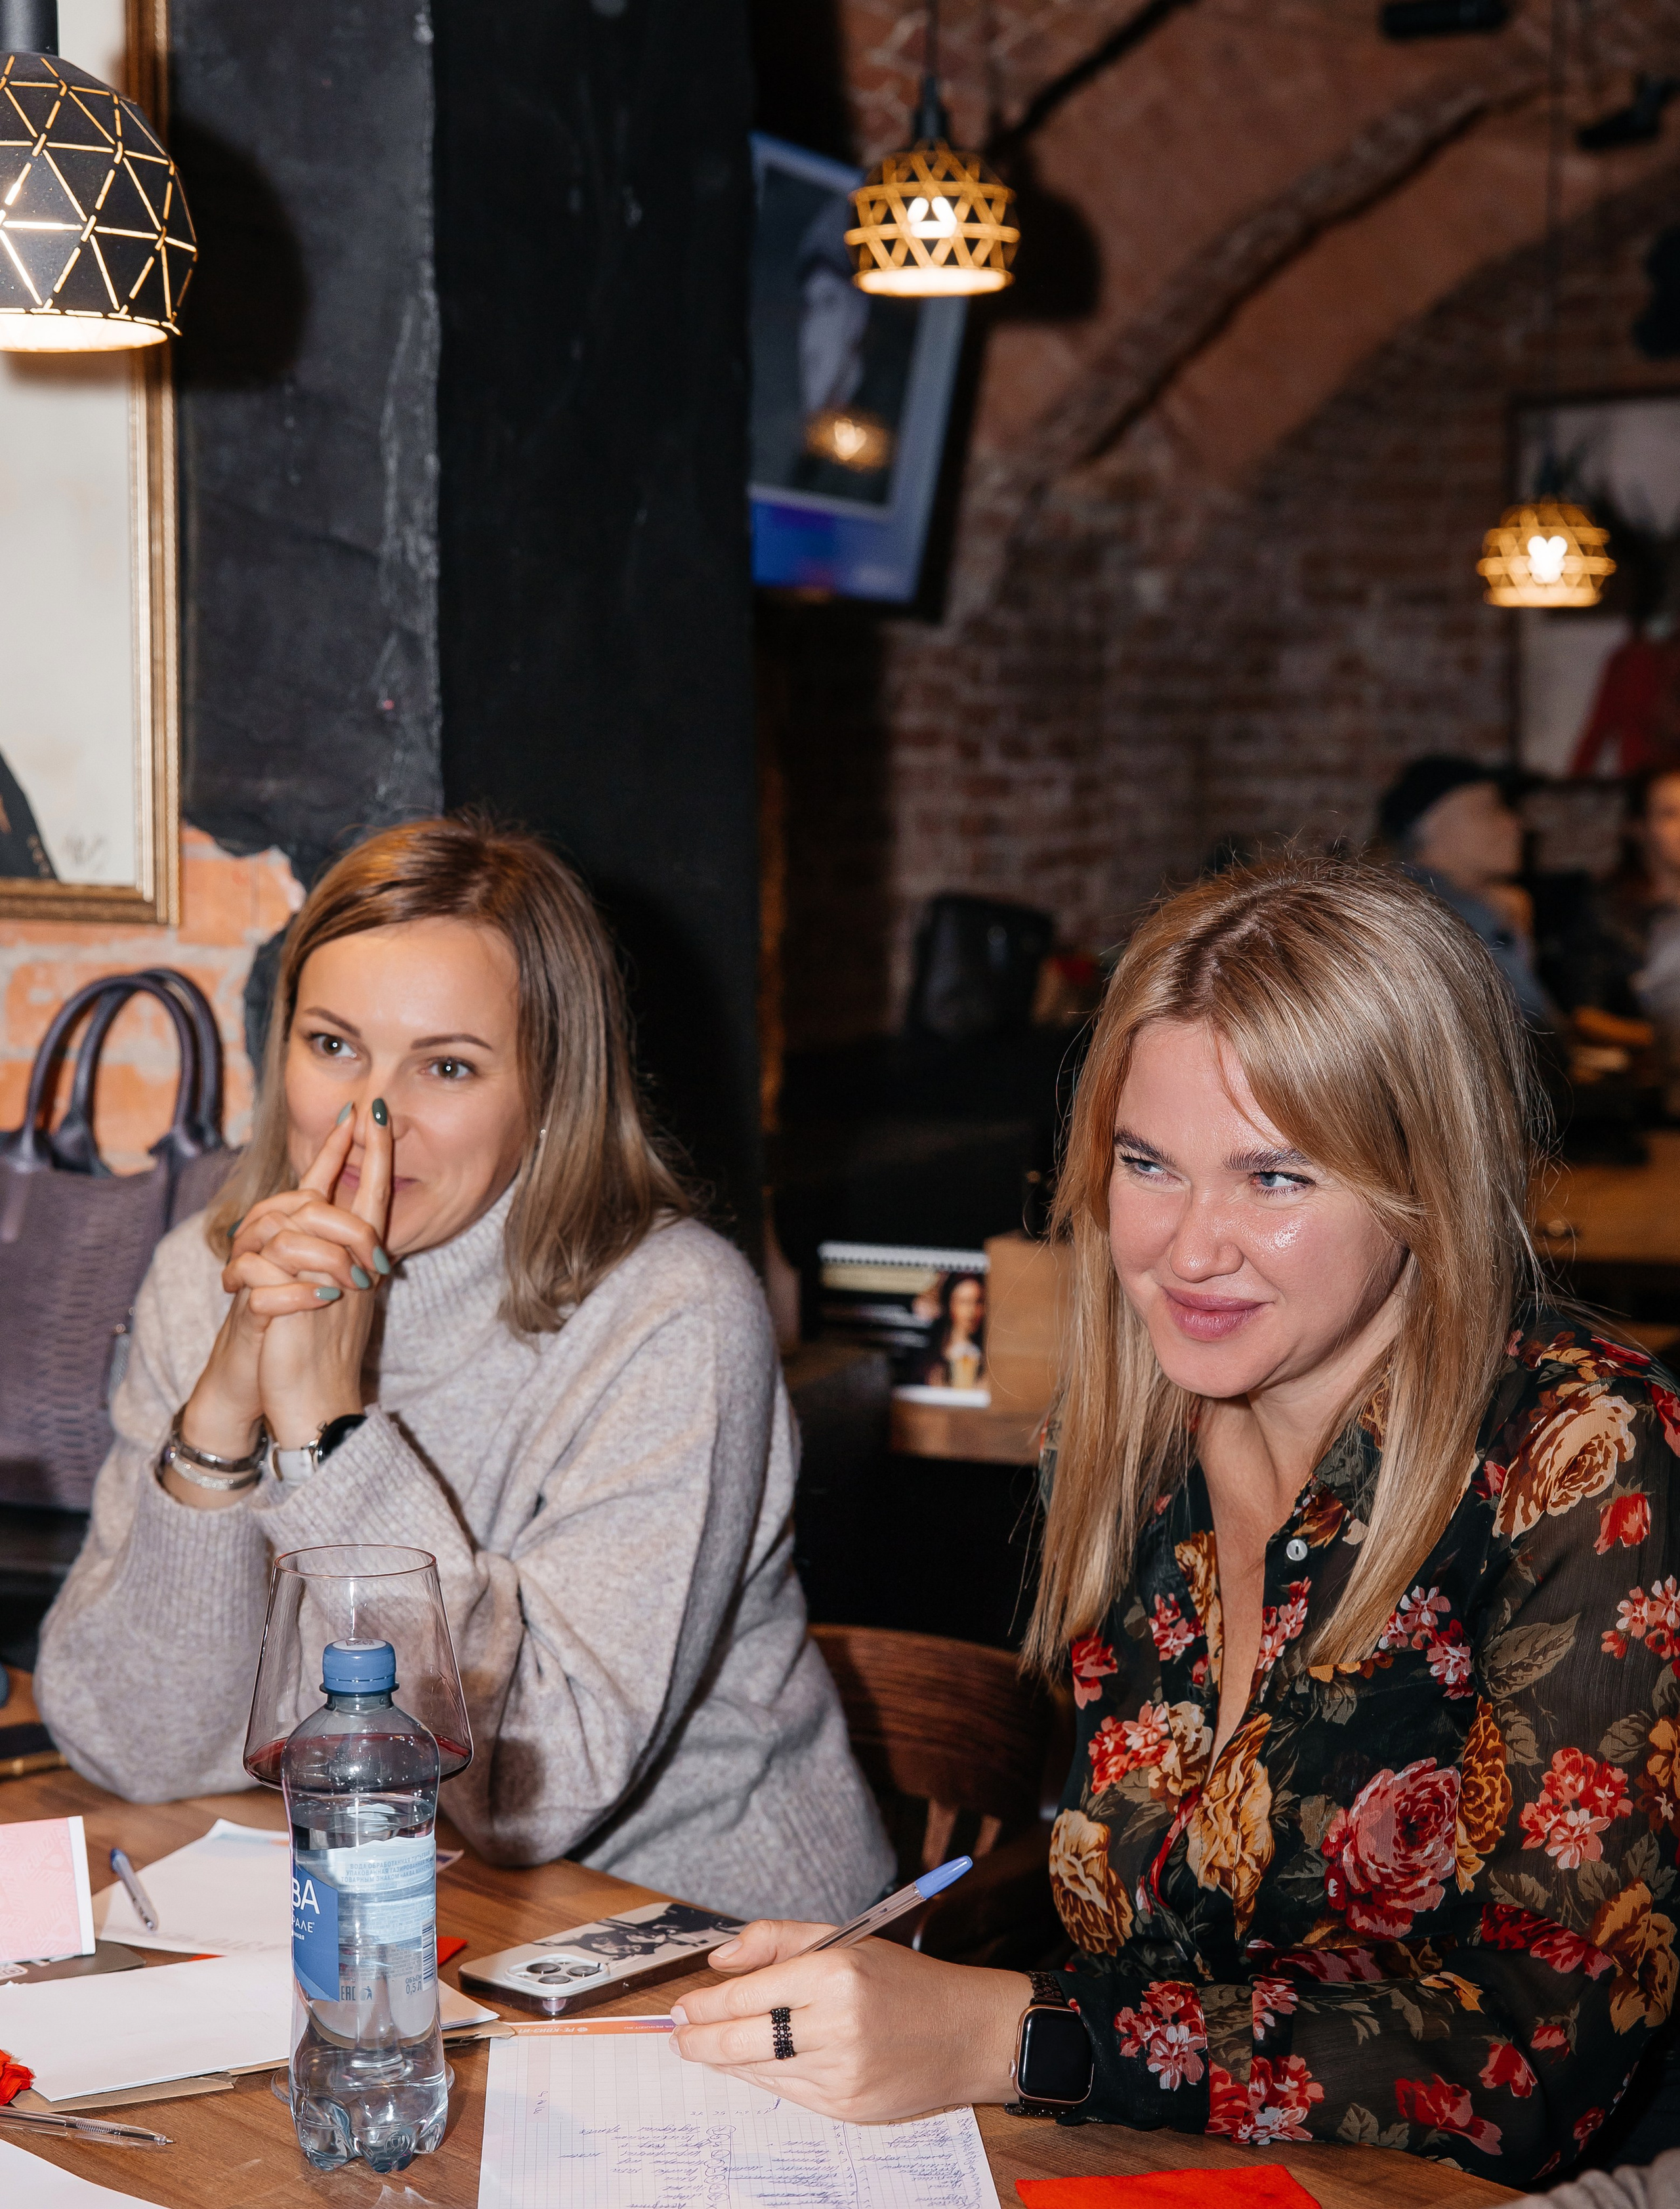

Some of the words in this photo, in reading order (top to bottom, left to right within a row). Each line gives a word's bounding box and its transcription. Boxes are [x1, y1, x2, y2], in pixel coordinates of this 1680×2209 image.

[368, 1857, 410, 1868] ОБРАБОТАННАЯ
[346, 1868, 389, 1876] УПАКОВАННАЯ
[406, 1984, 416, 1995] 0,5
